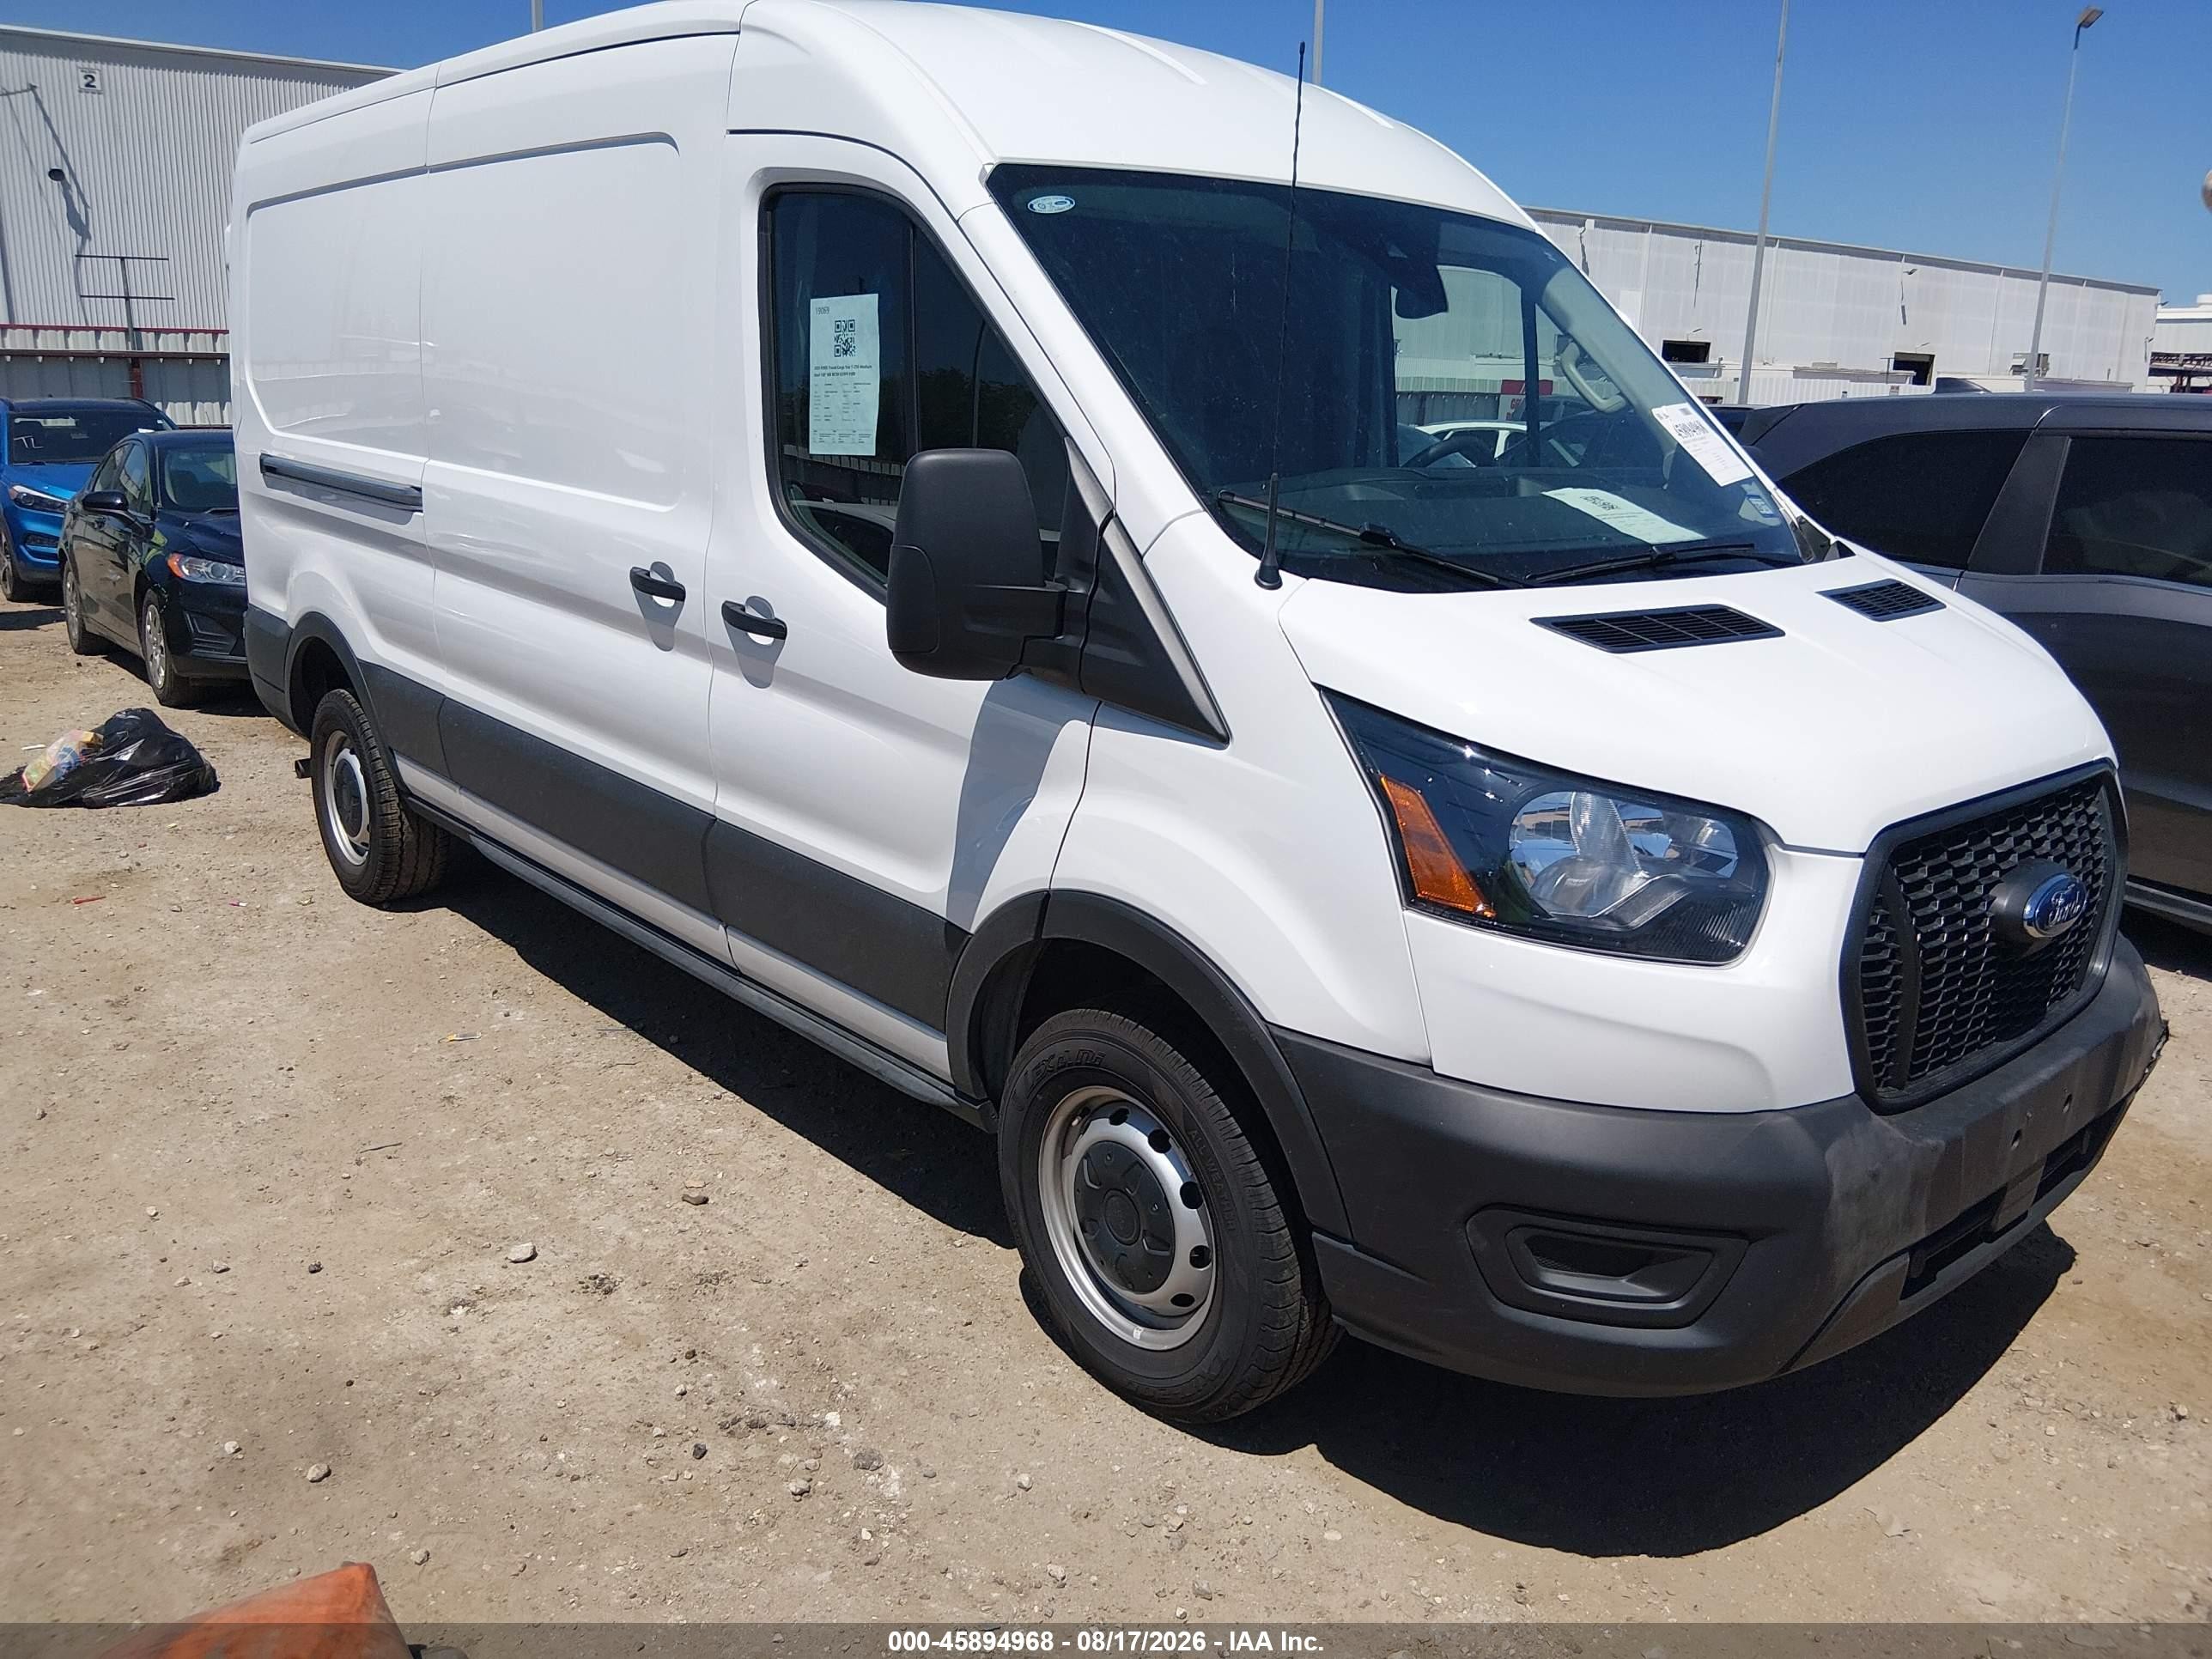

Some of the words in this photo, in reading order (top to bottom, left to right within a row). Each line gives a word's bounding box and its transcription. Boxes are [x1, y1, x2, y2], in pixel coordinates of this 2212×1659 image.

[83, 74, 96, 88] 2
[2048, 884, 2081, 927] Ford
[1187, 1128, 1207, 1157] ALL
[1206, 1156, 1237, 1231] WEATHER
